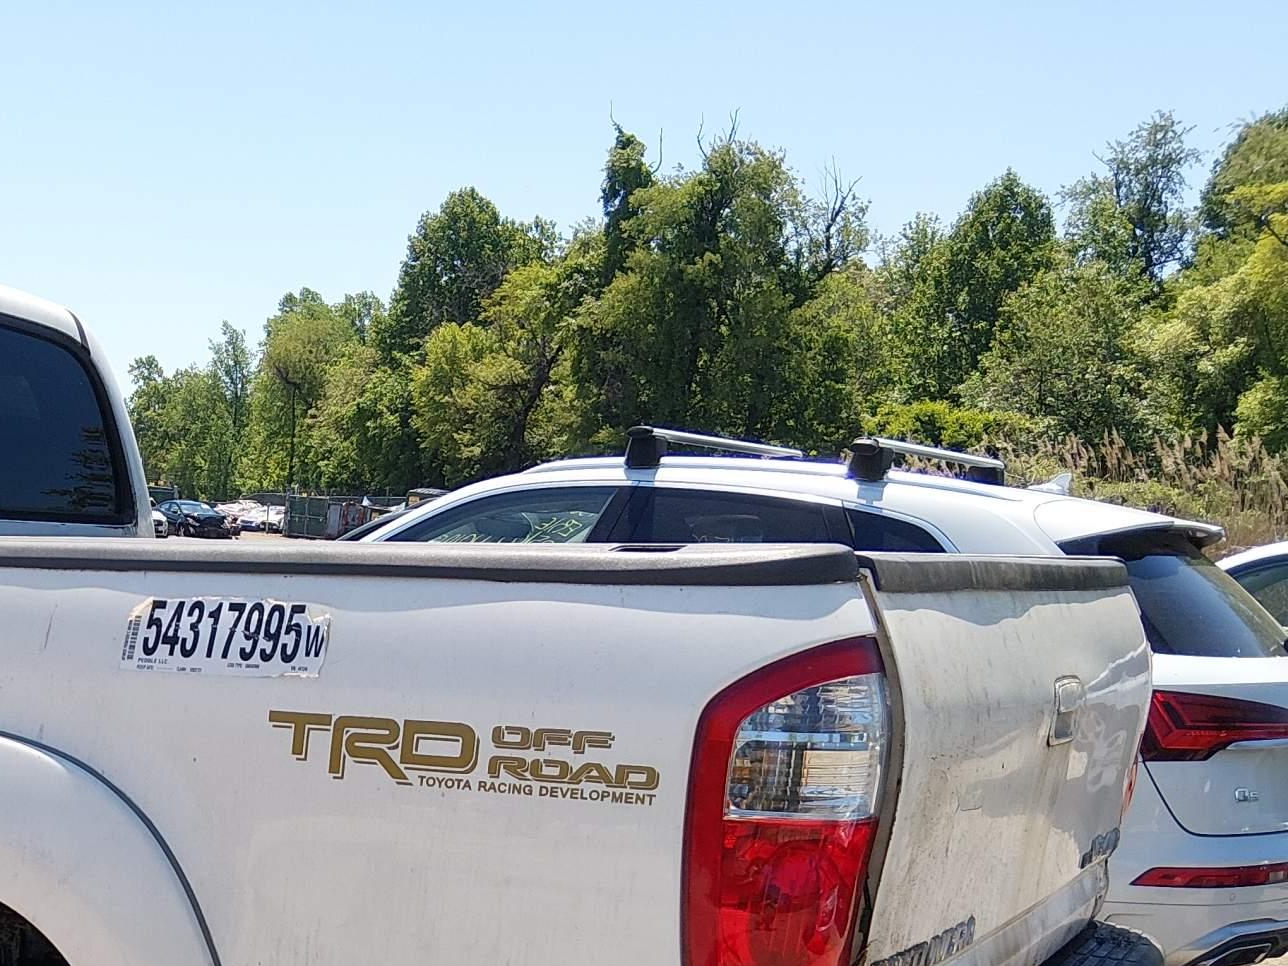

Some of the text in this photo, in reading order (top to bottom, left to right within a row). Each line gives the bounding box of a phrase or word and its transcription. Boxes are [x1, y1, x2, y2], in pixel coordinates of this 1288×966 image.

[268, 710, 616, 785] TRD OFF
[417, 775, 657, 807] TOYOTA RACING DEVELOPMENT
[487, 754, 661, 791] ROAD
